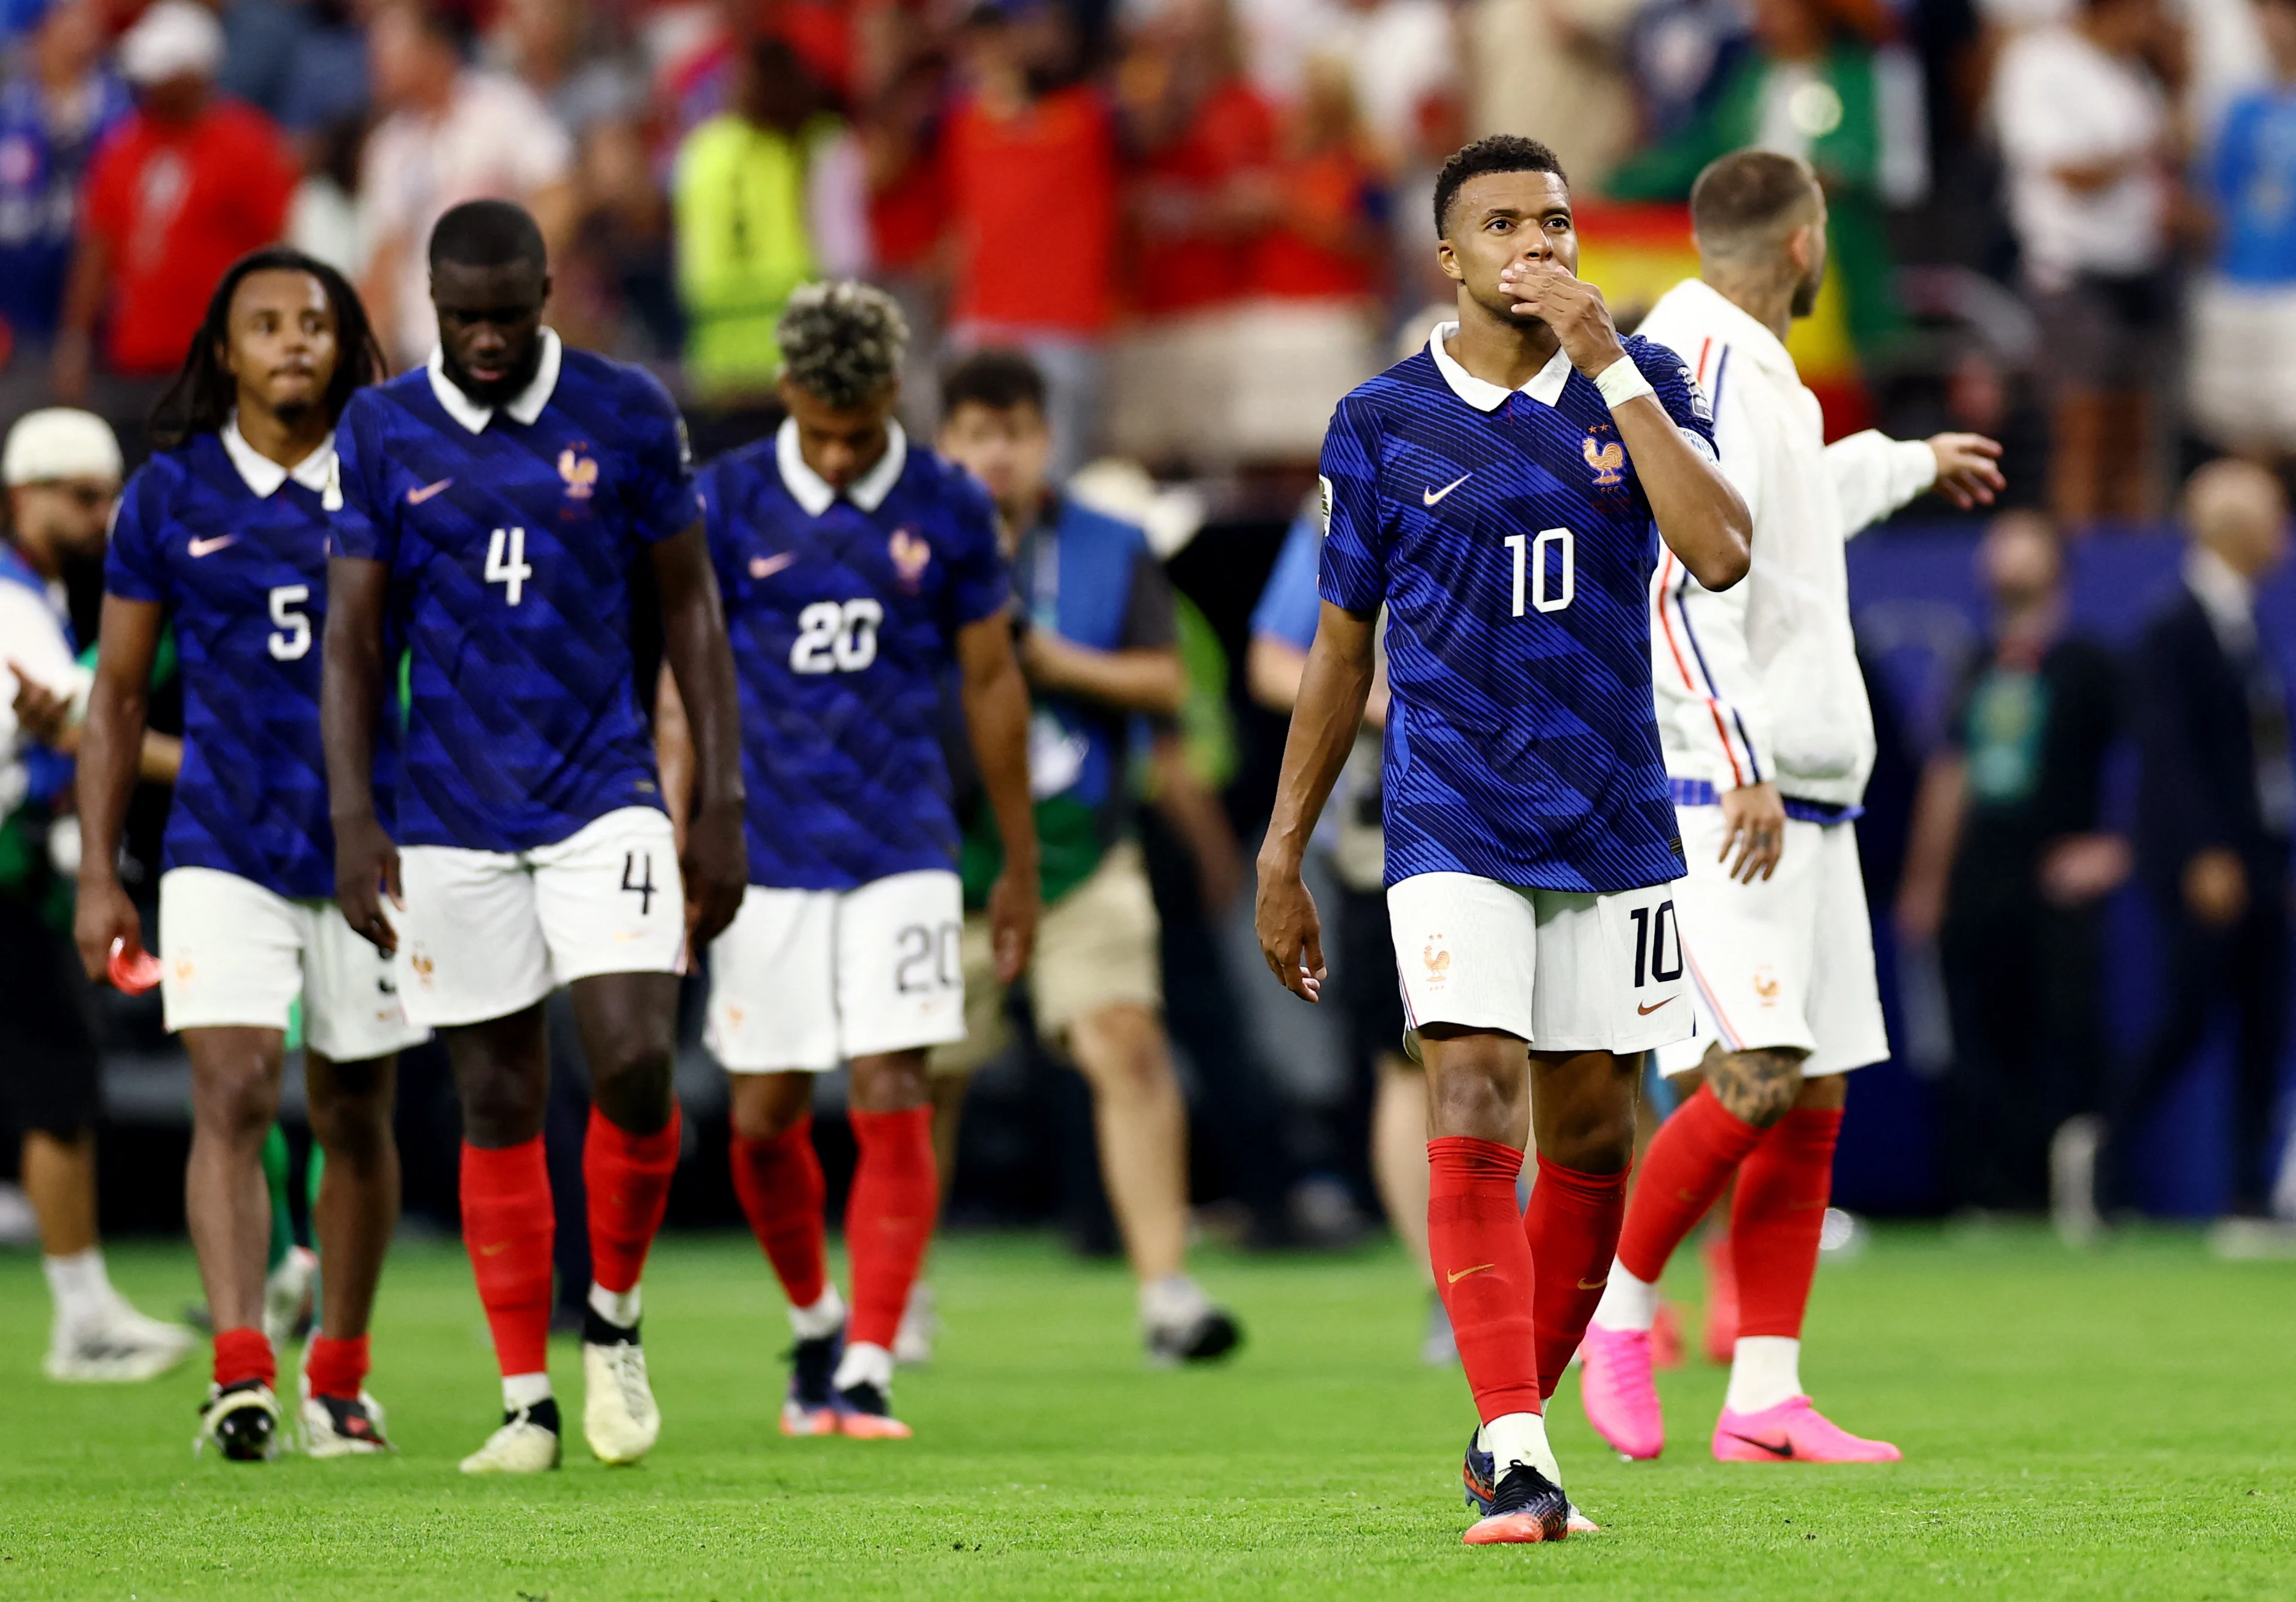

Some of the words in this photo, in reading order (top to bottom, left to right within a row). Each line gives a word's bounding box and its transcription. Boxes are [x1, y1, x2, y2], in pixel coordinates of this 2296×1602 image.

[484, 526, 532, 606] 4
[1504, 527, 1574, 617] 10
[268, 585, 311, 661] 5
[790, 598, 884, 675] 20
[620, 850, 659, 916] 4
[1631, 900, 1684, 988] 10
